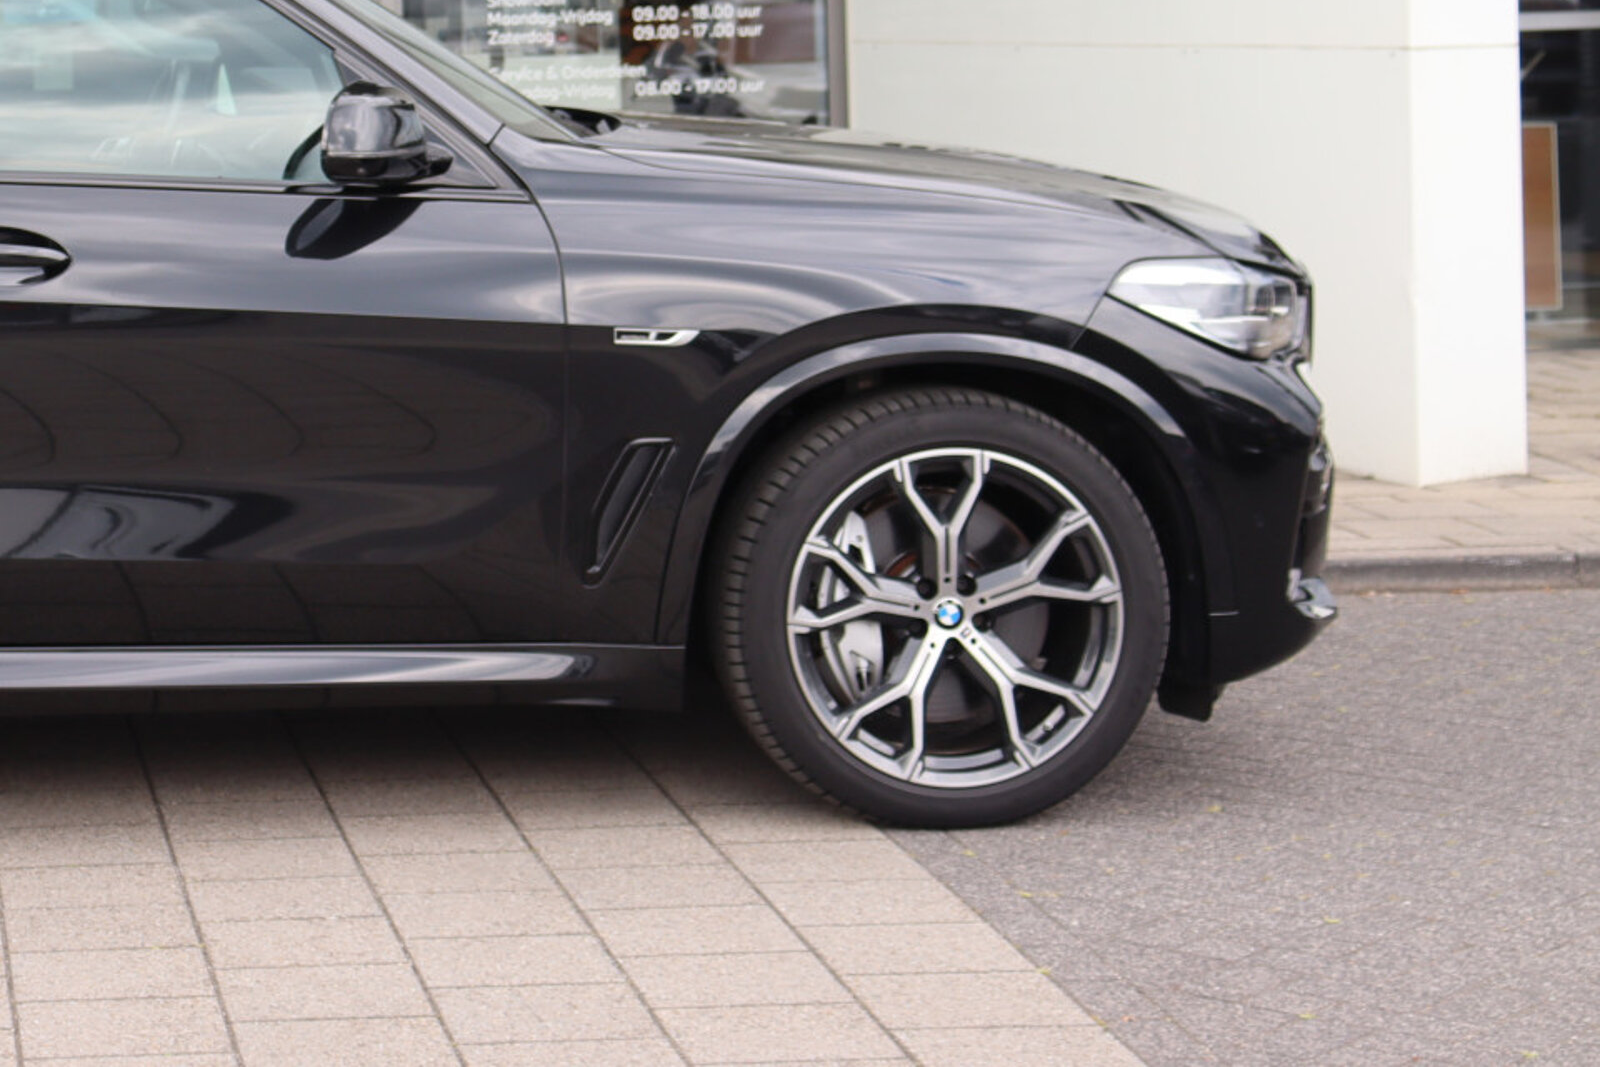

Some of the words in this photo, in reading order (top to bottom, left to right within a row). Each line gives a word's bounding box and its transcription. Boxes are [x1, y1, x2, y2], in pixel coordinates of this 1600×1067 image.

[632, 4, 680, 22] 09.00
[488, 30, 555, 47] Zaterdag
[633, 22, 680, 41] 09.00
